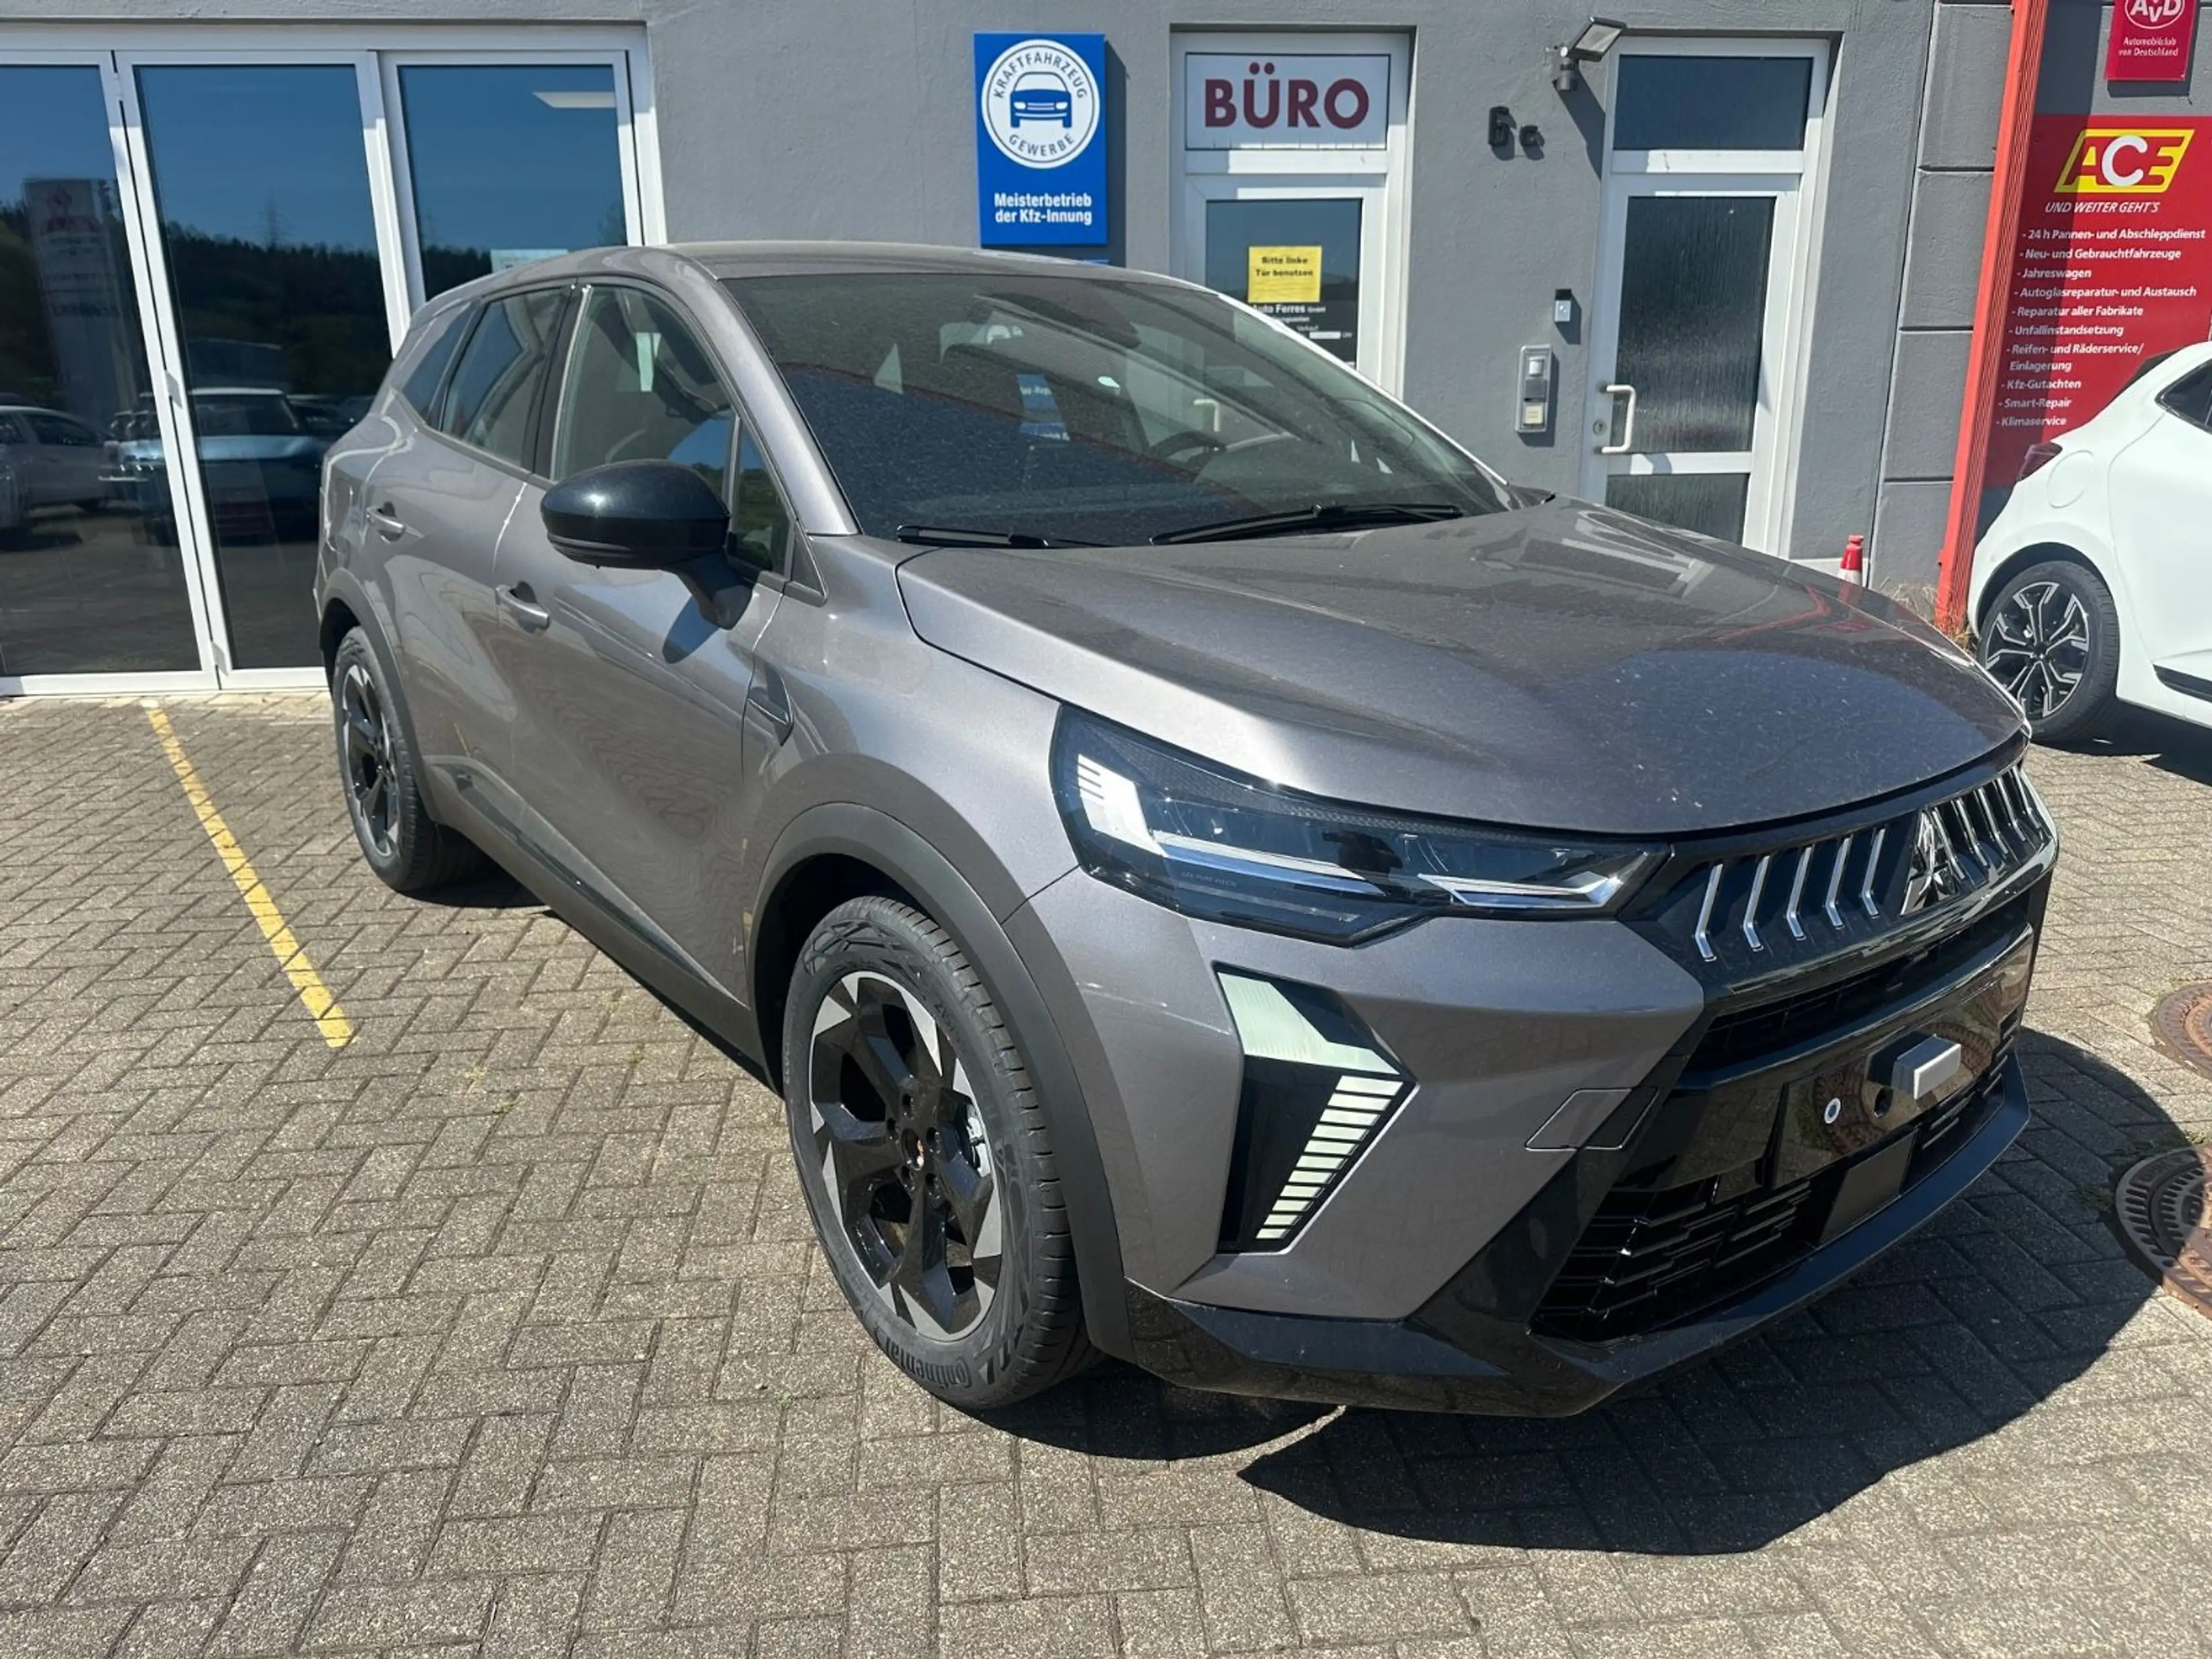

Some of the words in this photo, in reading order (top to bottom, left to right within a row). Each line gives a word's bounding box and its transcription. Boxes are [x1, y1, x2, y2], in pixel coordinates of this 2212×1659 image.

[2130, 0, 2181, 22] AvD
[2123, 37, 2177, 46] Automobilclub
[2133, 47, 2179, 56] Deutschland
[994, 51, 1088, 99] KRAFTFAHRZEUG
[1205, 62, 1370, 129] BÜRO
[1009, 132, 1075, 157] GEWERBE
[2060, 131, 2188, 190] ACE
[994, 192, 1092, 207] Meisterbetrieb
[2045, 202, 2072, 213] UND
[2073, 202, 2118, 213] WEITER
[995, 209, 1018, 222] der
[1020, 209, 1093, 226] Kfz-Innung
[2028, 229, 2043, 239] 24
[2043, 229, 2050, 239] h
[2052, 230, 2095, 240] Pannen-
[2096, 230, 2116, 239] und
[2119, 229, 2206, 241] Abschleppdienst
[2025, 249, 2050, 259] Neu-
[2052, 249, 2074, 259] und
[2075, 249, 2182, 261] Gebrauchtfahrzeuge
[2022, 268, 2092, 280] Jahreswagen
[2020, 287, 2120, 299] Autoglasreparatur-
[2121, 287, 2141, 297] und
[2143, 287, 2197, 297] Austausch
[2017, 306, 2069, 318] Reparatur
[2070, 306, 2093, 316] aller
[2096, 306, 2143, 316] Fabrikate
[2014, 325, 2124, 337] Unfallinstandsetzung
[2012, 344, 2048, 354] Reifen-
[2050, 344, 2071, 354] und
[2073, 343, 2143, 355] Räderservice/
[2009, 361, 2072, 372] Einlagerung
[2007, 379, 2081, 390] Kfz-Gutachten
[2003, 397, 2071, 409] Smart-Repair
[2001, 416, 2067, 427] Klimaservice
